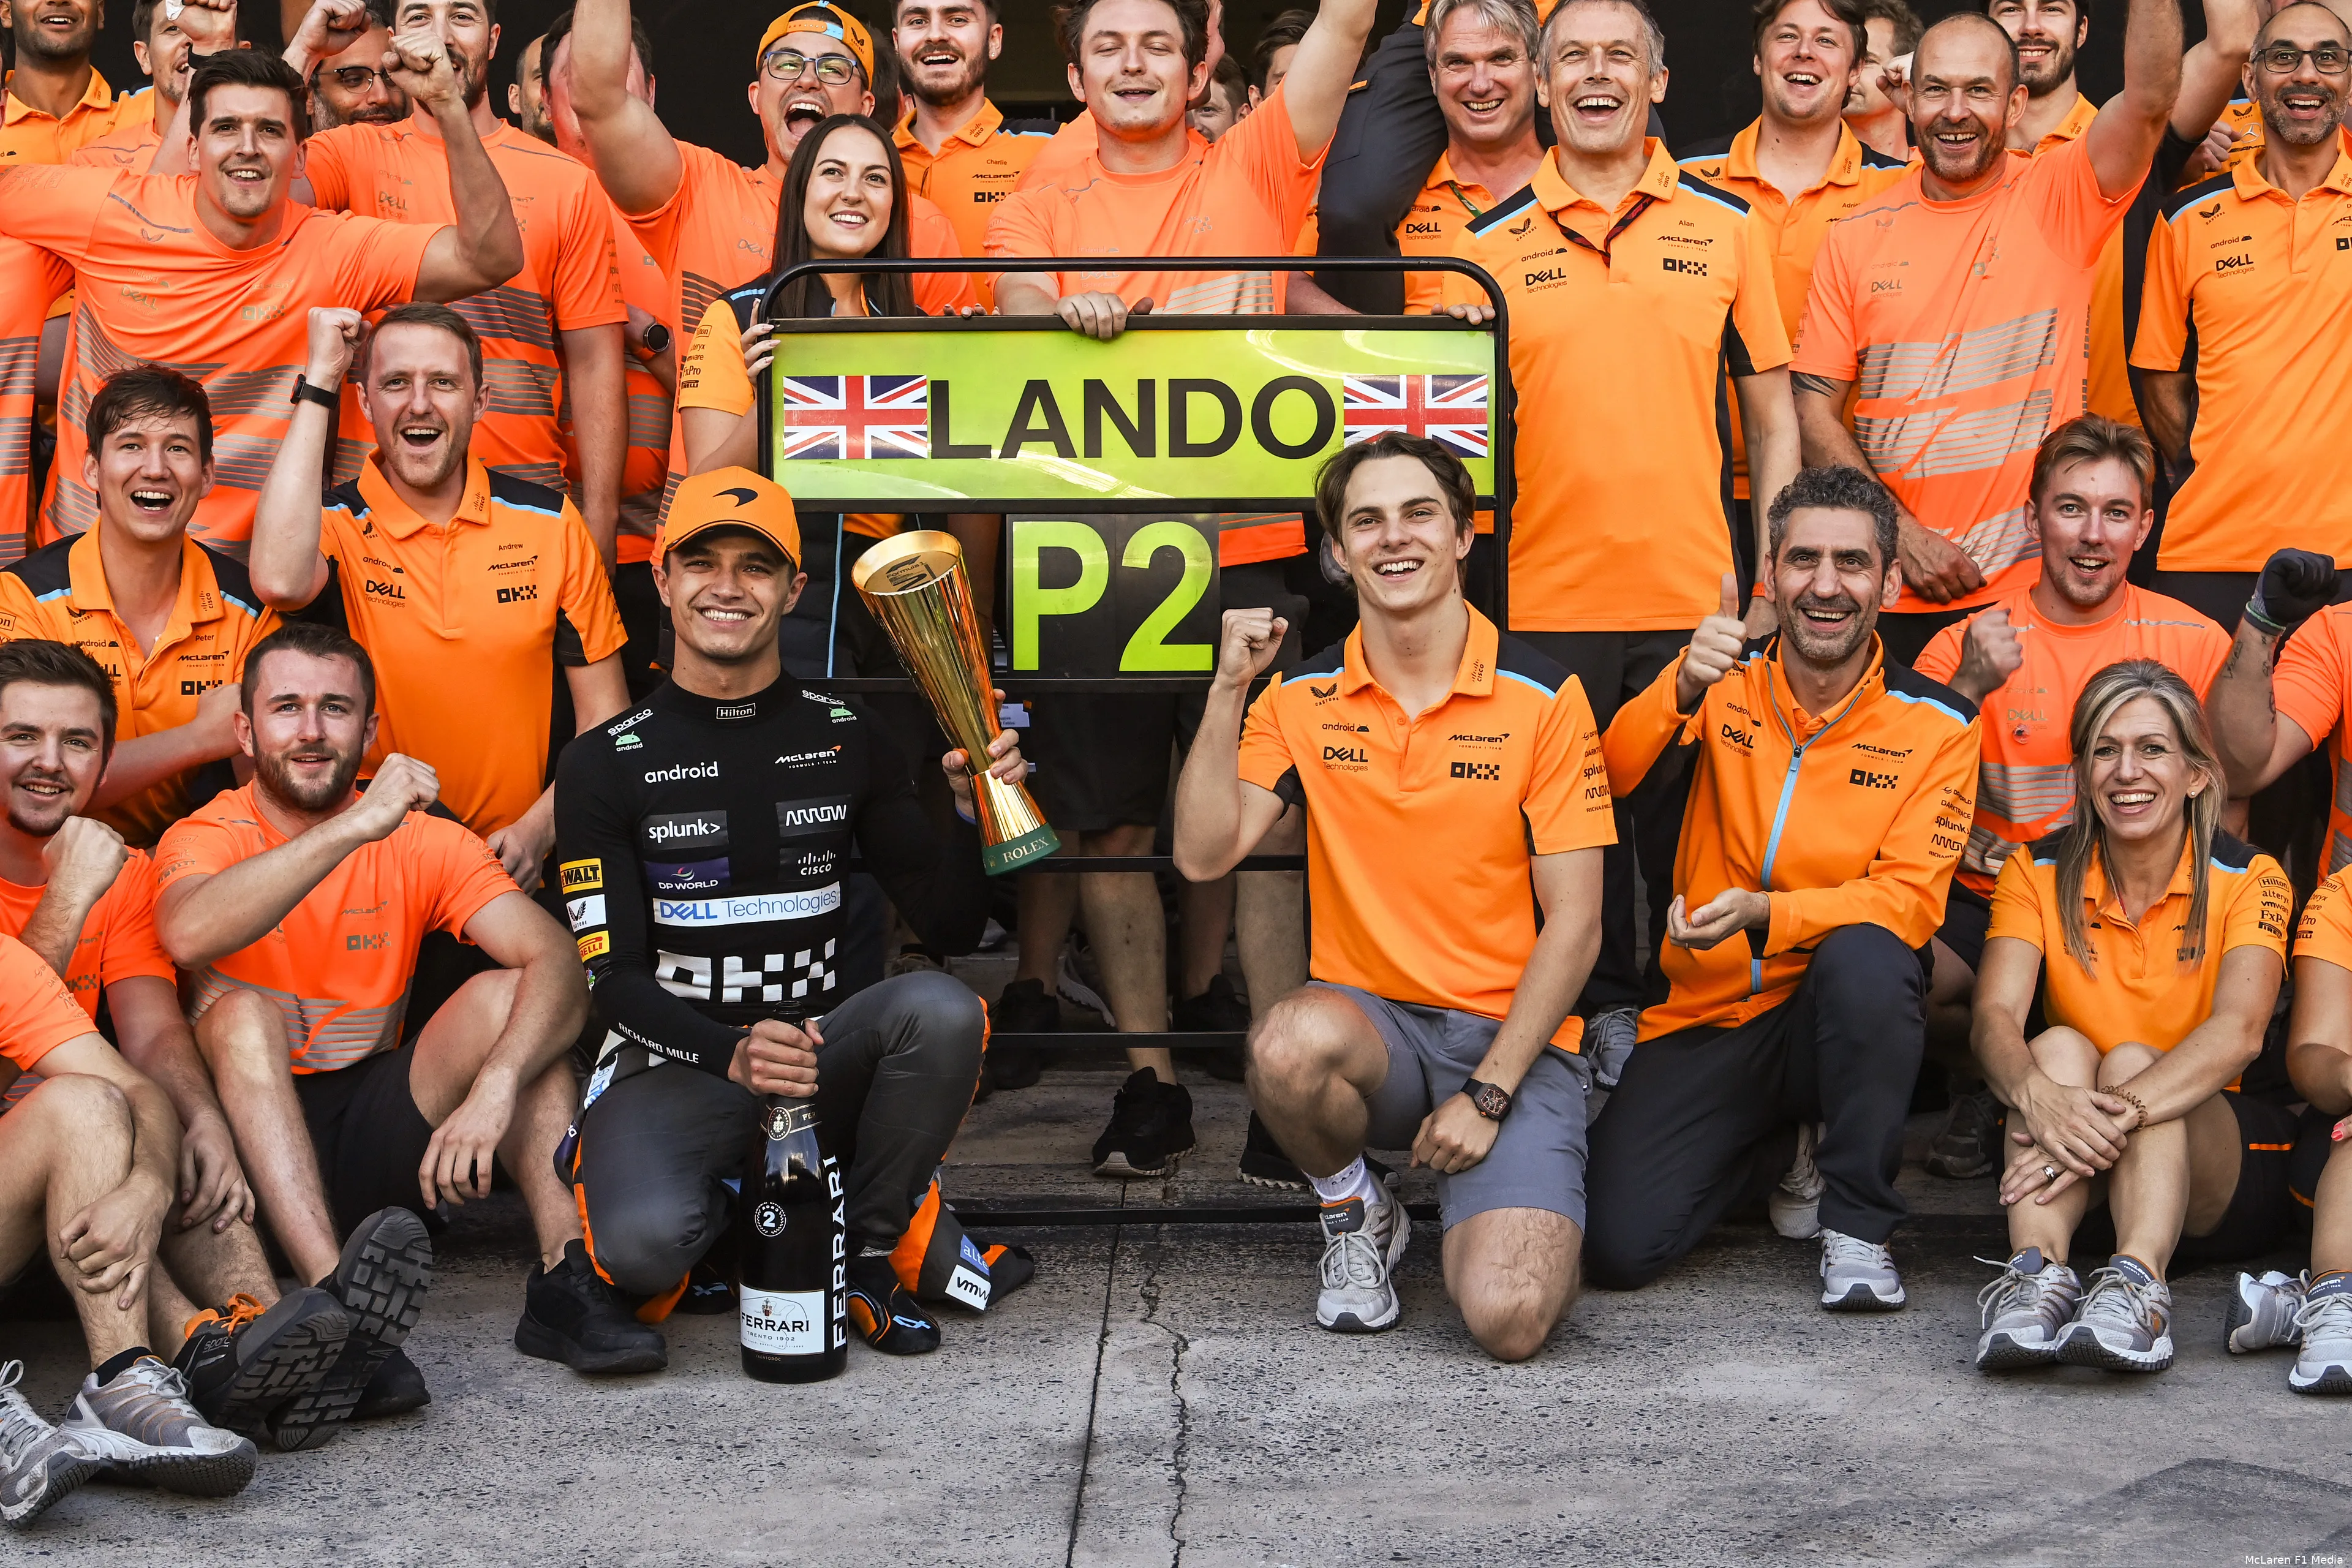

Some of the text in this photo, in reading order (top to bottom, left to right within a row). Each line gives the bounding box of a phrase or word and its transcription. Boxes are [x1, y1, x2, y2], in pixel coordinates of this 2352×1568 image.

[379, 190, 408, 211] DELL
[1406, 222, 1442, 234] DELL
[1678, 219, 1694, 228] Alan
[1516, 225, 1537, 242] CASTORE
[1657, 236, 1711, 246] McLaren
[2210, 236, 2240, 249] android
[1520, 247, 1554, 262] android
[2216, 253, 2255, 271] DELL
[1662, 258, 1708, 276] OKX
[2217, 266, 2255, 279] Technologies
[1525, 267, 1567, 286] DELL
[1526, 280, 1567, 294] Technologies
[1871, 279, 1902, 293] DELL
[121, 285, 158, 311] DELL
[930, 375, 1336, 459] LANDO
[486, 557, 536, 571] McLaren
[365, 579, 406, 599] DELL
[496, 584, 538, 603] OKX
[1013, 521, 1212, 671] P2
[364, 594, 405, 608] Technologies
[72, 614, 93, 625] CASTORE
[177, 653, 227, 662] McLaren
[802, 690, 846, 705] sparco
[1314, 697, 1340, 707] CASTORE
[720, 707, 753, 717] Hilton
[2007, 708, 2048, 721] DELL
[607, 709, 654, 736] sparco
[1322, 722, 1355, 733] android
[1447, 734, 1506, 744] McLaren
[1721, 723, 1754, 748] DELL
[616, 742, 644, 752] android
[1323, 746, 1369, 763] DELL
[1721, 736, 1752, 758] Technologies
[1851, 744, 1910, 758] McLaren
[774, 748, 838, 764] McLaren
[644, 761, 719, 783] android
[1323, 762, 1369, 772] Technologies
[1450, 762, 1500, 781] OKX
[1849, 769, 1899, 789] OKX
[785, 804, 847, 827] ARROW
[1940, 799, 1972, 820] DARKTRACE
[649, 818, 721, 843] splunk>
[1002, 836, 1049, 864] ROLEX
[658, 880, 719, 891] DP WORLD
[2262, 878, 2288, 889] Hilton
[2262, 890, 2290, 903] alteryx
[660, 890, 837, 921] DELL Technologies
[2260, 910, 2286, 930] FxPro
[656, 938, 835, 1002] OKX
[618, 1022, 699, 1064] RICHARD MILLE
[763, 1211, 776, 1227] 2
[823, 1154, 846, 1350] FERRARI
[741, 1311, 810, 1332] FERRARI
[892, 1314, 931, 1330] 4
[747, 1330, 772, 1341] TRENTO
